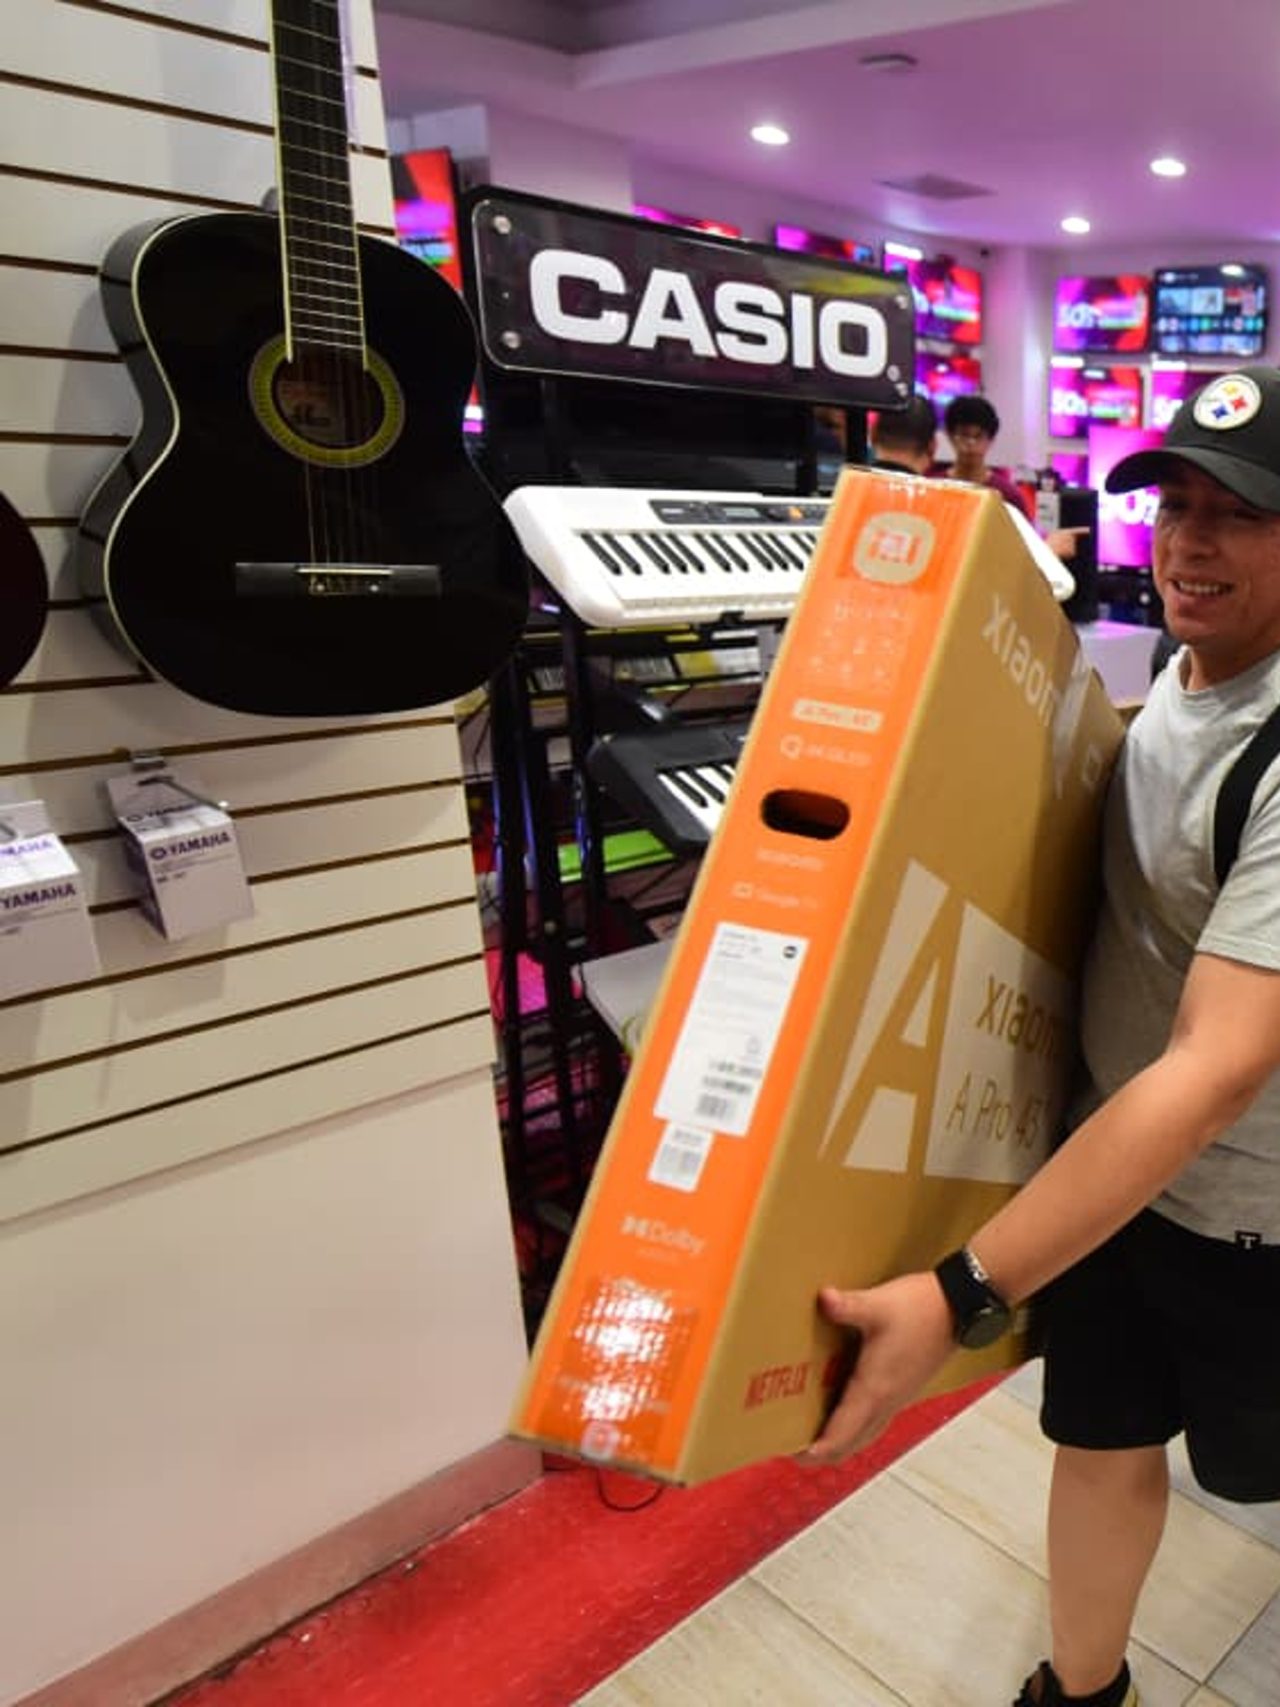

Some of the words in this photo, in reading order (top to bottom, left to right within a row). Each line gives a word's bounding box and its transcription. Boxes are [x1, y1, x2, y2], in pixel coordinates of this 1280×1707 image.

[529, 248, 888, 378] CASIO
[170, 831, 231, 854] YAMAHA
[0, 883, 76, 908] YAMAHA
